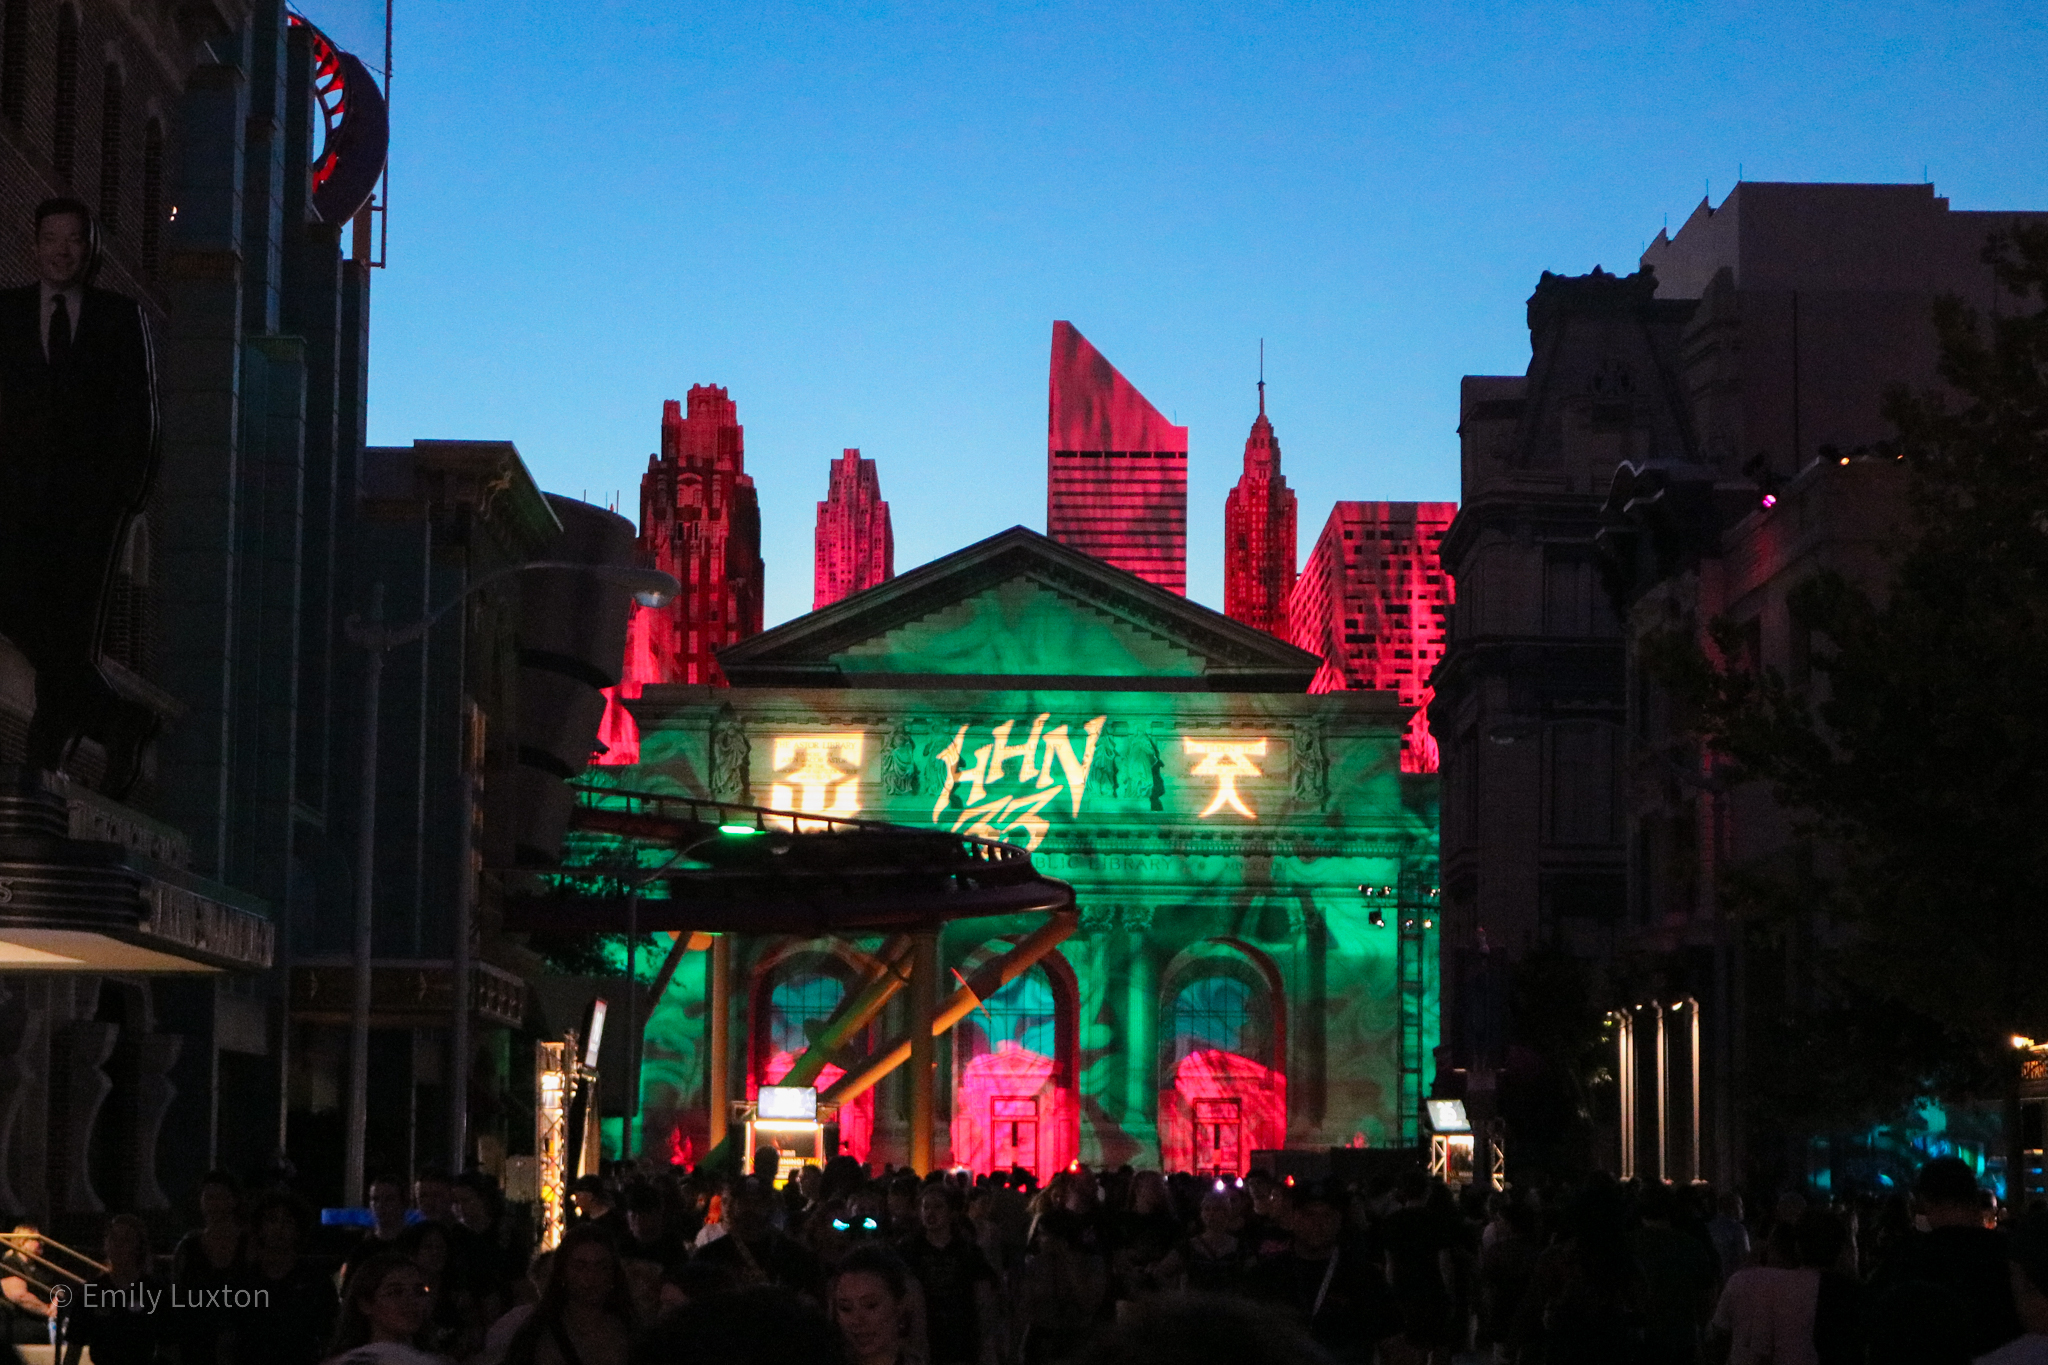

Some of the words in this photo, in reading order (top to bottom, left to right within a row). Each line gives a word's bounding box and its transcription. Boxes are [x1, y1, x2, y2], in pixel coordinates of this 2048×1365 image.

[794, 741, 819, 749] ASTOR
[822, 741, 856, 750] LIBRARY
[998, 743, 1026, 751] LENOX
[1028, 743, 1063, 751] LIBRARY
[1204, 745, 1235, 753] TILDEN
[932, 711, 1107, 824] HHN
[950, 784, 1064, 860] 33
[1035, 857, 1082, 869] BLIC
[1088, 857, 1173, 871] LIBRARY
